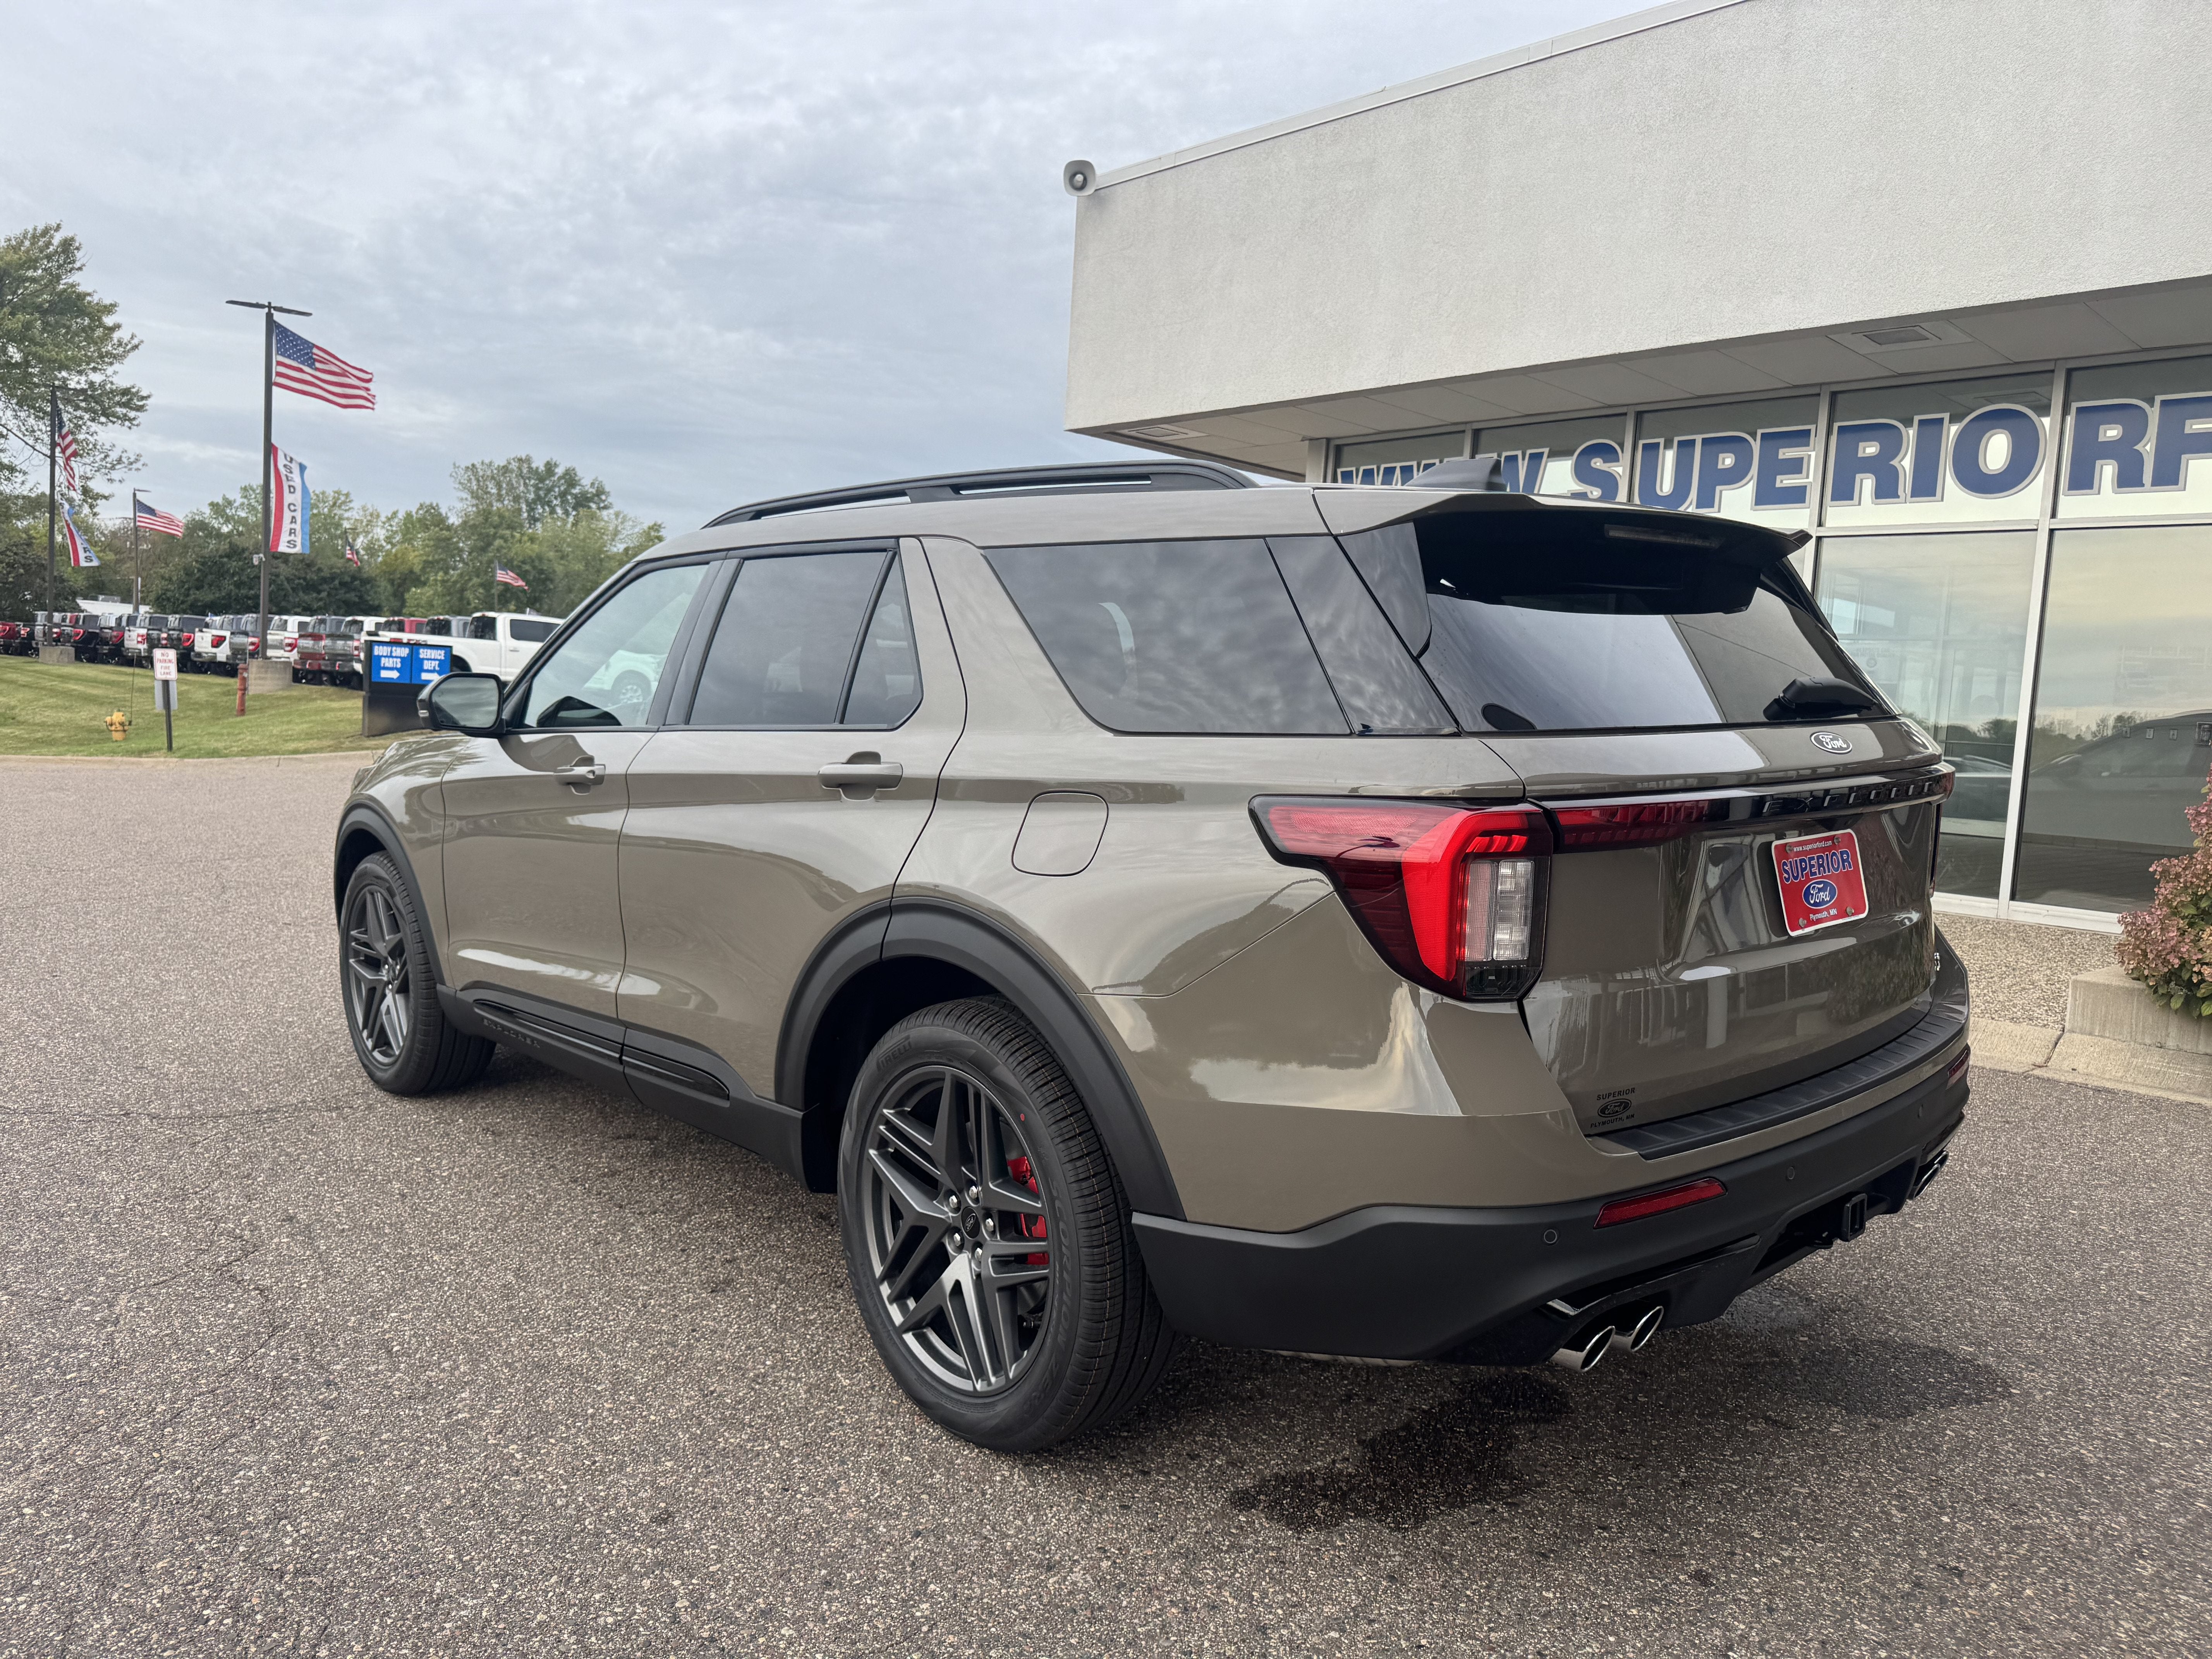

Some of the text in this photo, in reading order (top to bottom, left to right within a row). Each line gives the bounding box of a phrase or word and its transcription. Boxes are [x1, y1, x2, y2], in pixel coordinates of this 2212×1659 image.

[1337, 391, 2212, 513] SUPERIORF
[283, 453, 297, 549] USED CARS
[374, 645, 409, 657] BODY SHOP
[419, 649, 445, 660] SERVICE
[381, 657, 401, 668] PARTS
[423, 660, 440, 670] DEPT.
[1793, 840, 1832, 852] www.superiorford.com
[1781, 849, 1853, 884] SUPERIOR
[1809, 883, 1831, 904] Ford
[1810, 910, 1829, 921] Plymouth,
[876, 1034, 913, 1072] PIRELLI
[1597, 1087, 1635, 1101] SUPERIOR
[1605, 1103, 1625, 1114] Ford
[1590, 1116, 1624, 1128] PLYMOUTH,
[1048, 1176, 1072, 1351] SCORPION
